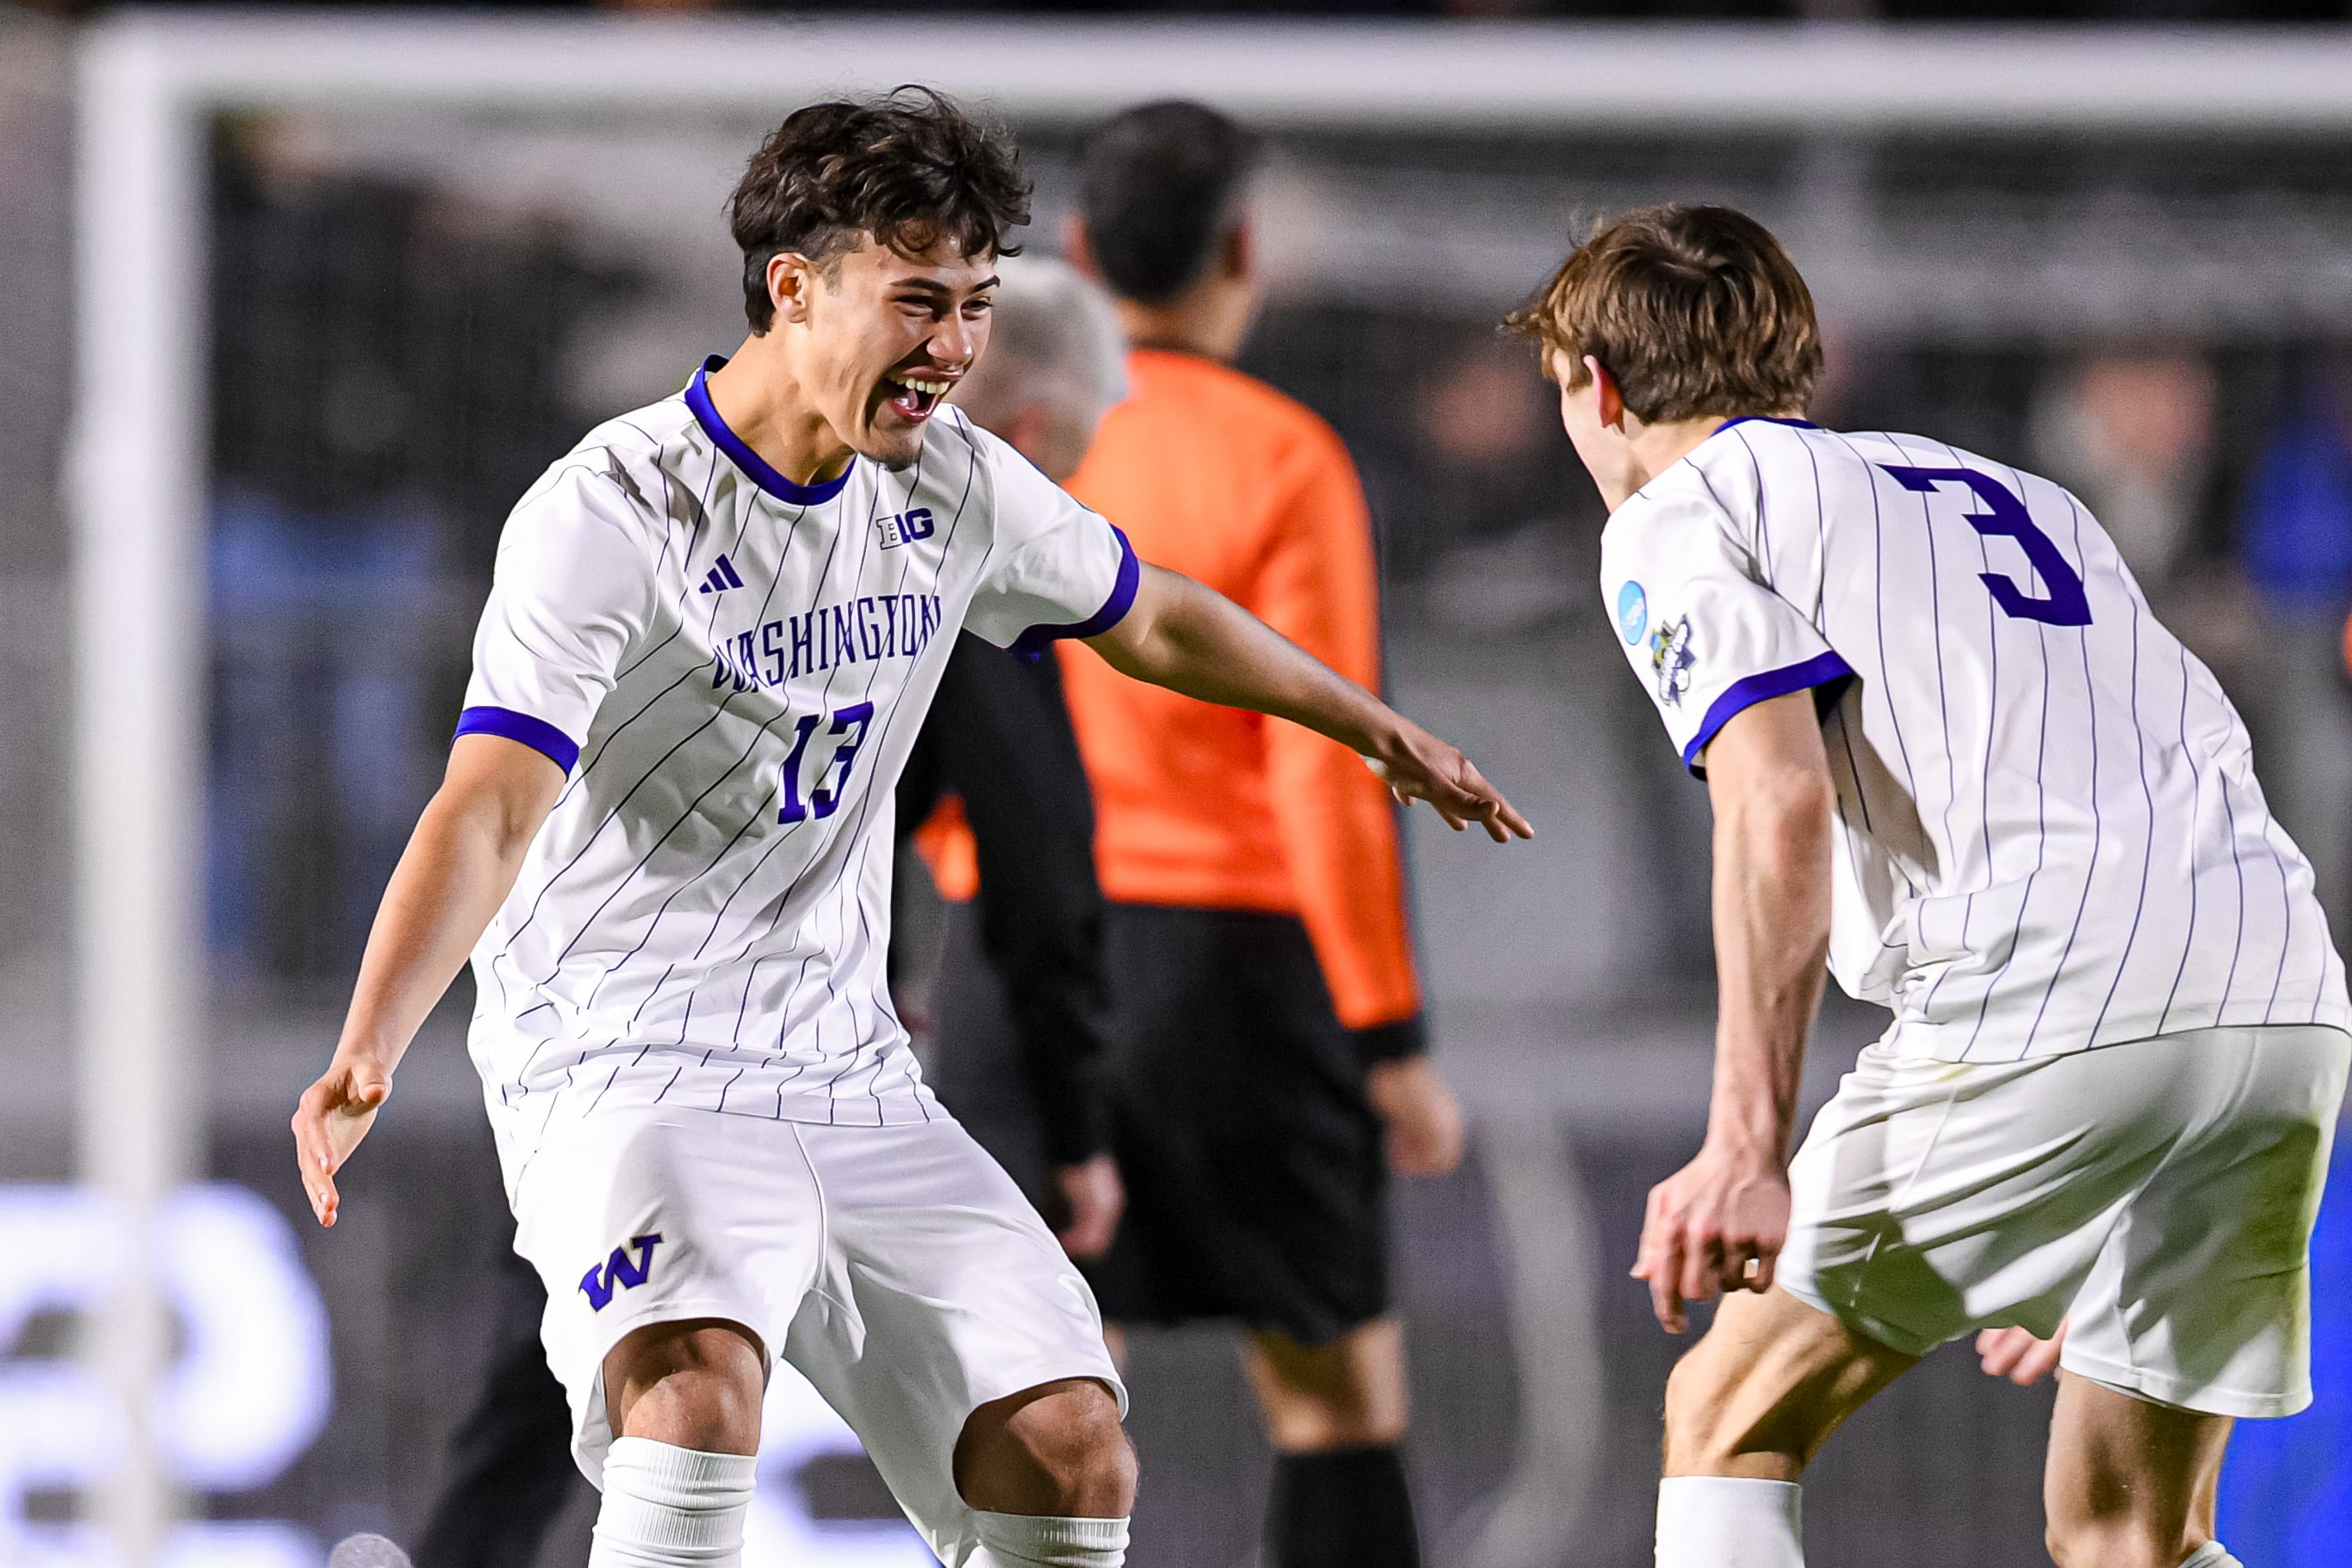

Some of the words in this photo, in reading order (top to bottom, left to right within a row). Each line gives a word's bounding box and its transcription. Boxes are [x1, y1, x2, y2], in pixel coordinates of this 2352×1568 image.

[1873, 463, 2094, 626] 3
[712, 595, 941, 693] WASHINGTON
[777, 701, 874, 824] 13
[577, 1231, 665, 1314] W
